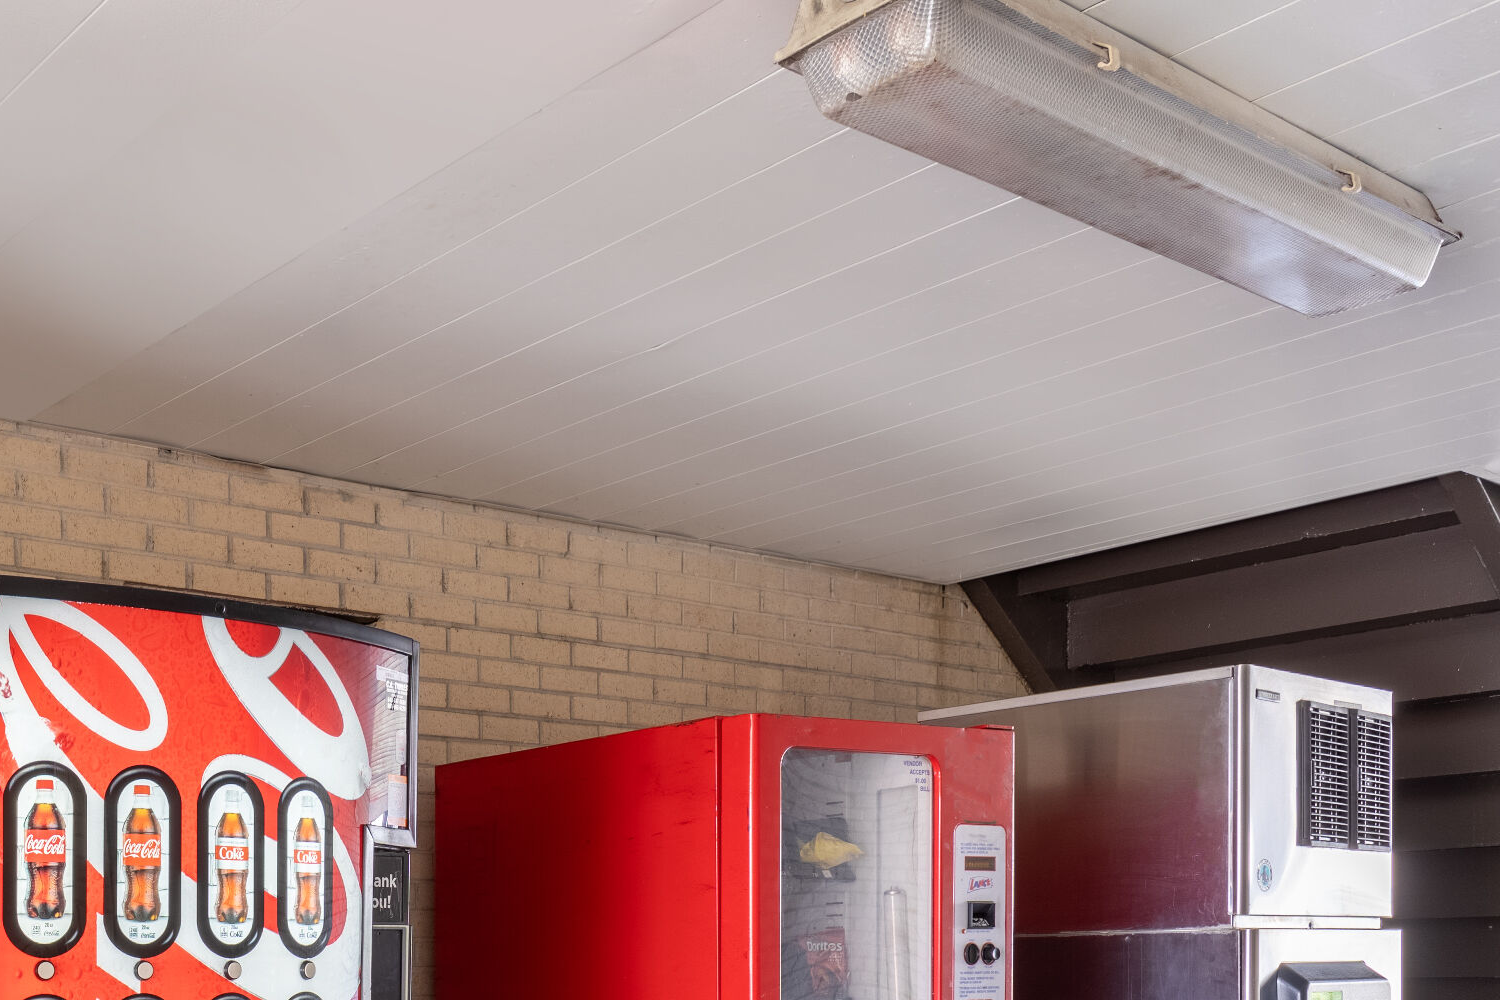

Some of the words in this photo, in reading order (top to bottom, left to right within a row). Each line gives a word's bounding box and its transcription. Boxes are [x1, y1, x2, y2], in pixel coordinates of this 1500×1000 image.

[25, 834, 66, 855] Coca-Cola
[123, 838, 161, 859] Coca-Cola
[219, 846, 244, 860] Coke
[296, 850, 318, 863] Coke
[373, 874, 397, 888] ank
[372, 895, 391, 909] ou!
[806, 941, 843, 952] Doritos
